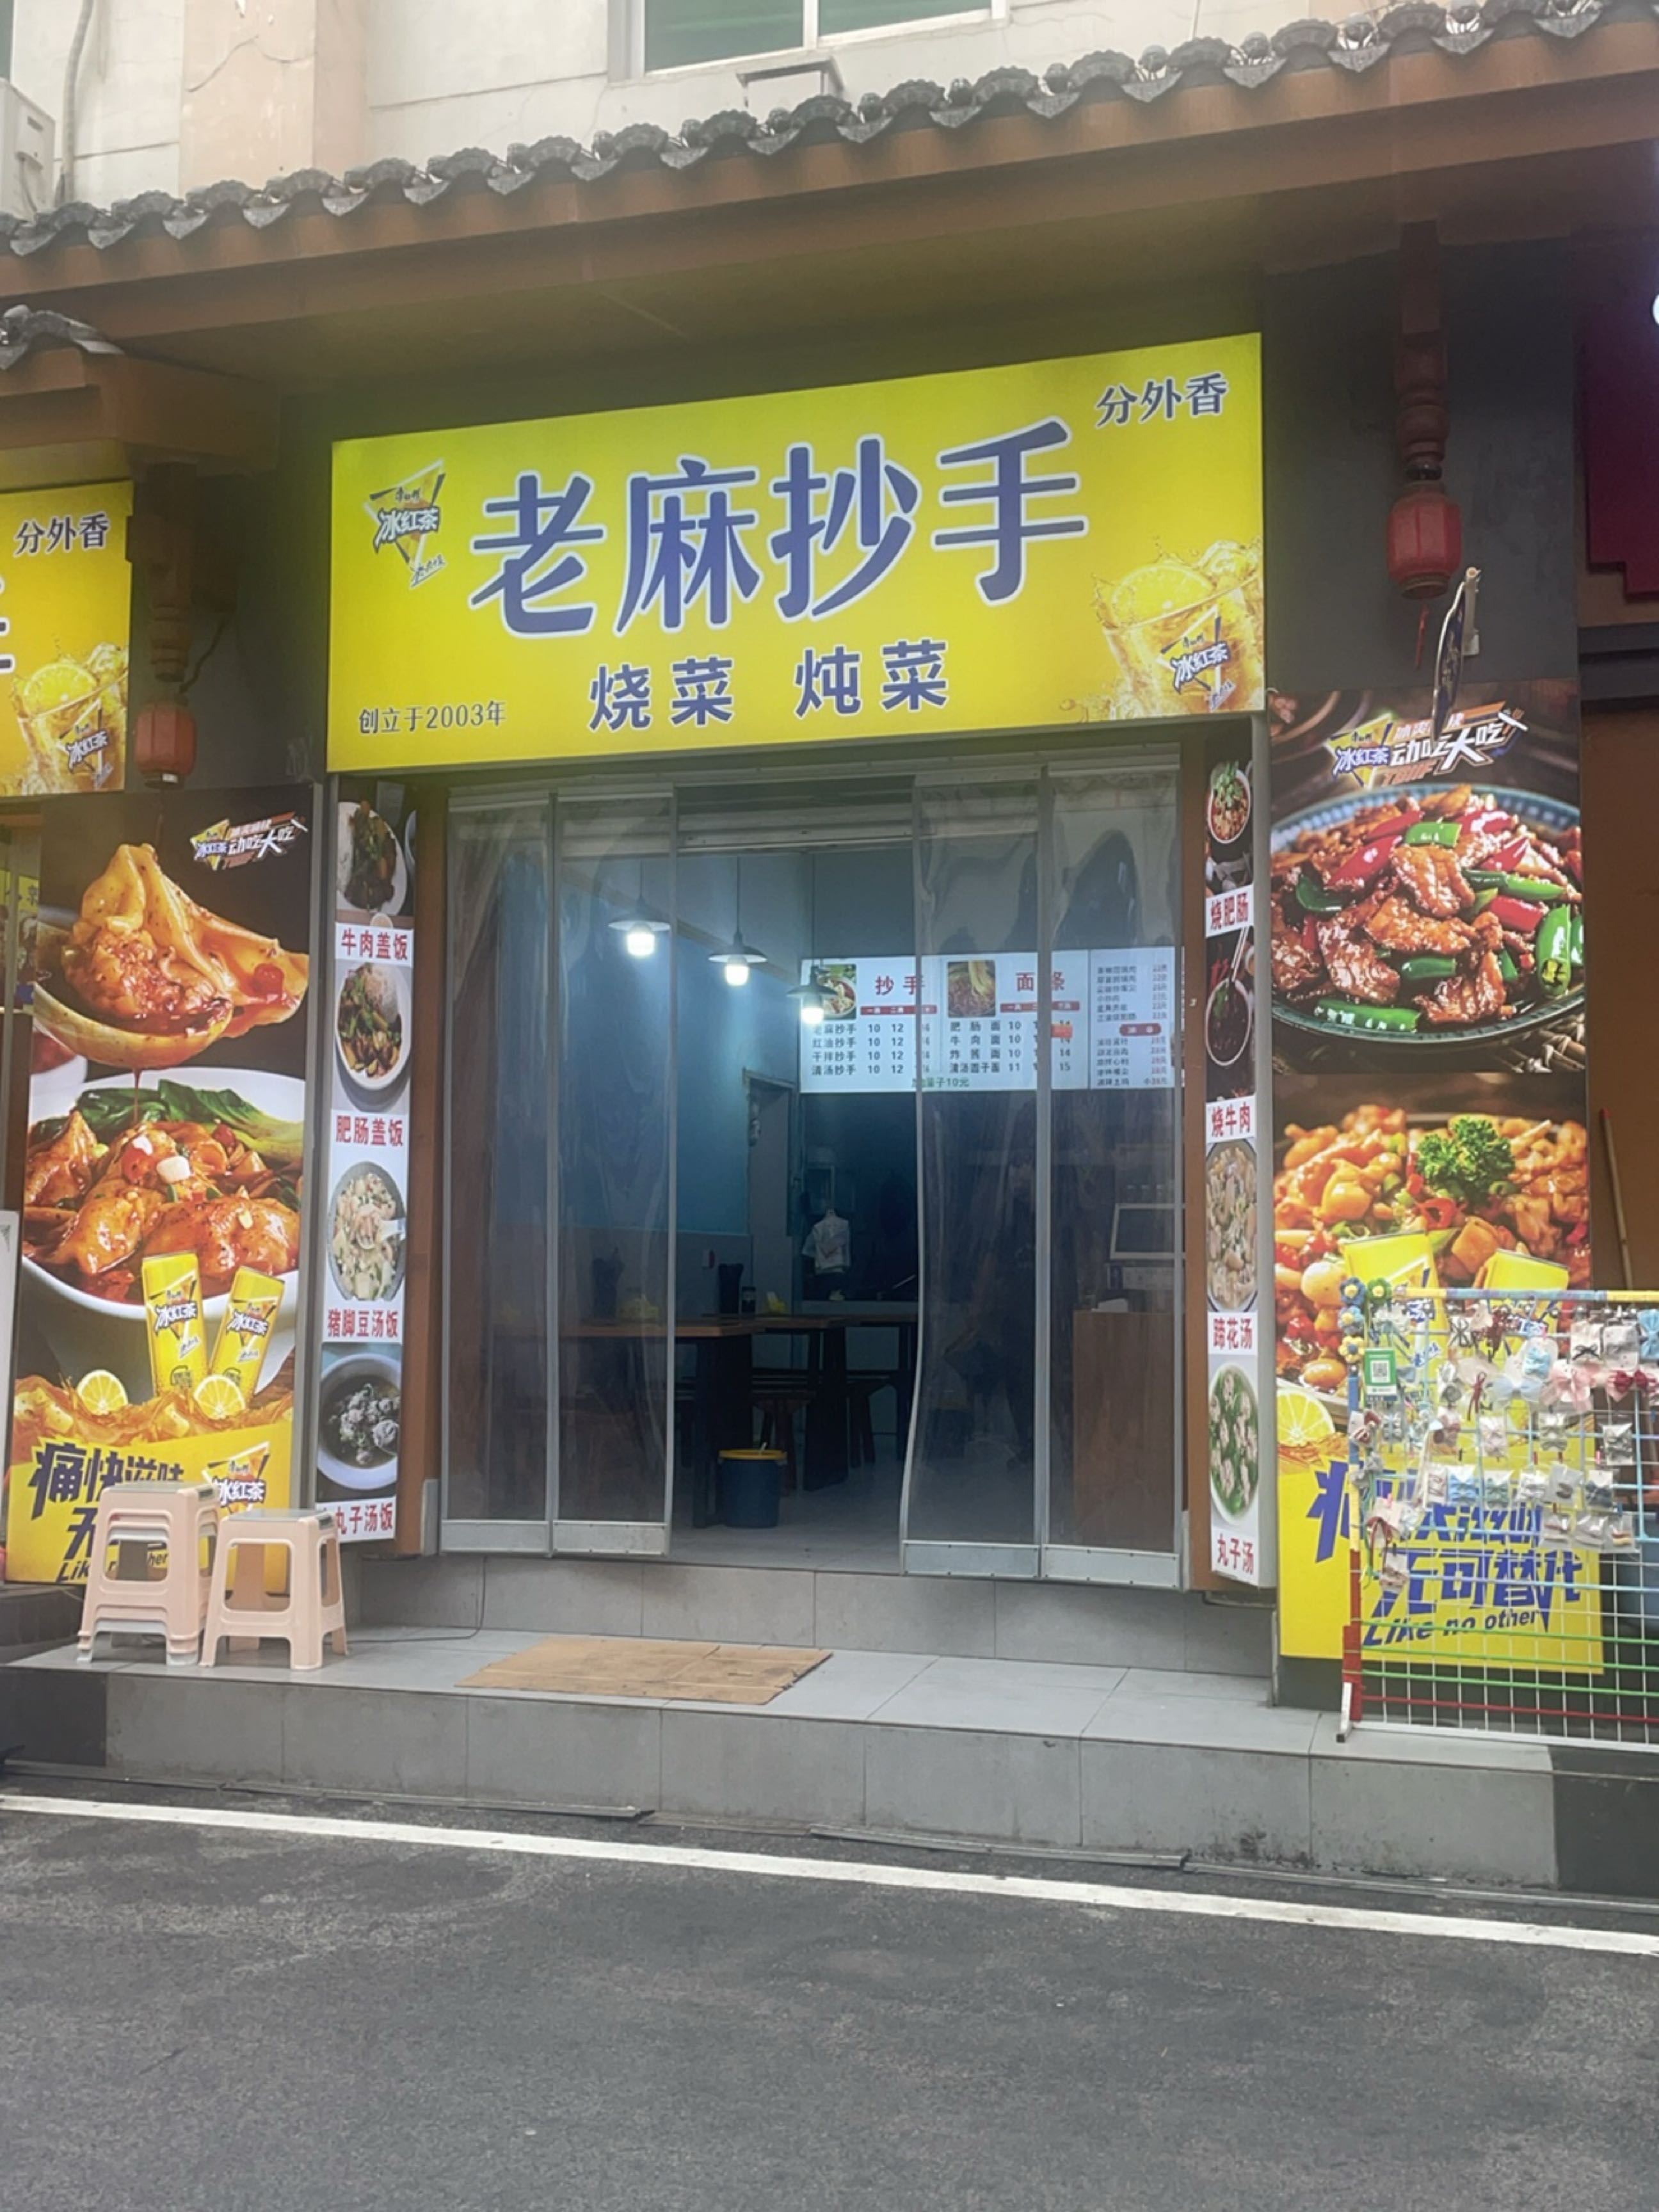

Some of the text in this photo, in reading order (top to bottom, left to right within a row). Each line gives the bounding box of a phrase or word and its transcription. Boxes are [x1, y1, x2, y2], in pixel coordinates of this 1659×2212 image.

[1096, 372, 1228, 428] 分外香
[14, 512, 109, 557] 分外香
[373, 506, 440, 554] 冰红茶
[470, 418, 1087, 637] 老麻抄手
[1171, 641, 1231, 695] 冰红茶
[588, 639, 948, 732] 烧菜 炖菜
[359, 700, 506, 734] 创立于2003年
[1333, 744, 1391, 780] 冰红茶
[1211, 892, 1249, 930] 烧肥肠
[341, 927, 408, 961] 牛肉盖饭
[875, 975, 926, 996] 抄手
[868, 1023, 881, 1033] 10
[891, 1023, 904, 1033] 12
[868, 1038, 881, 1046] 10
[891, 1038, 904, 1046] 12
[1008, 1021, 1021, 1030] 10
[1008, 1034, 1021, 1044] 10
[868, 1051, 881, 1060] 10
[891, 1051, 904, 1060] 12
[868, 1065, 881, 1074] 10
[891, 1065, 904, 1074] 12
[1008, 1048, 1021, 1057] 10
[336, 1115, 404, 1148] 肥肠盖饭
[1212, 1102, 1250, 1137] 烧牛肉
[328, 1309, 398, 1338] 猪脚豆汤饭
[322, 1502, 392, 1534] 丸子汤饭
[1217, 1531, 1254, 1575] 丸子汤
[1362, 1608, 1541, 1647] Like no other
